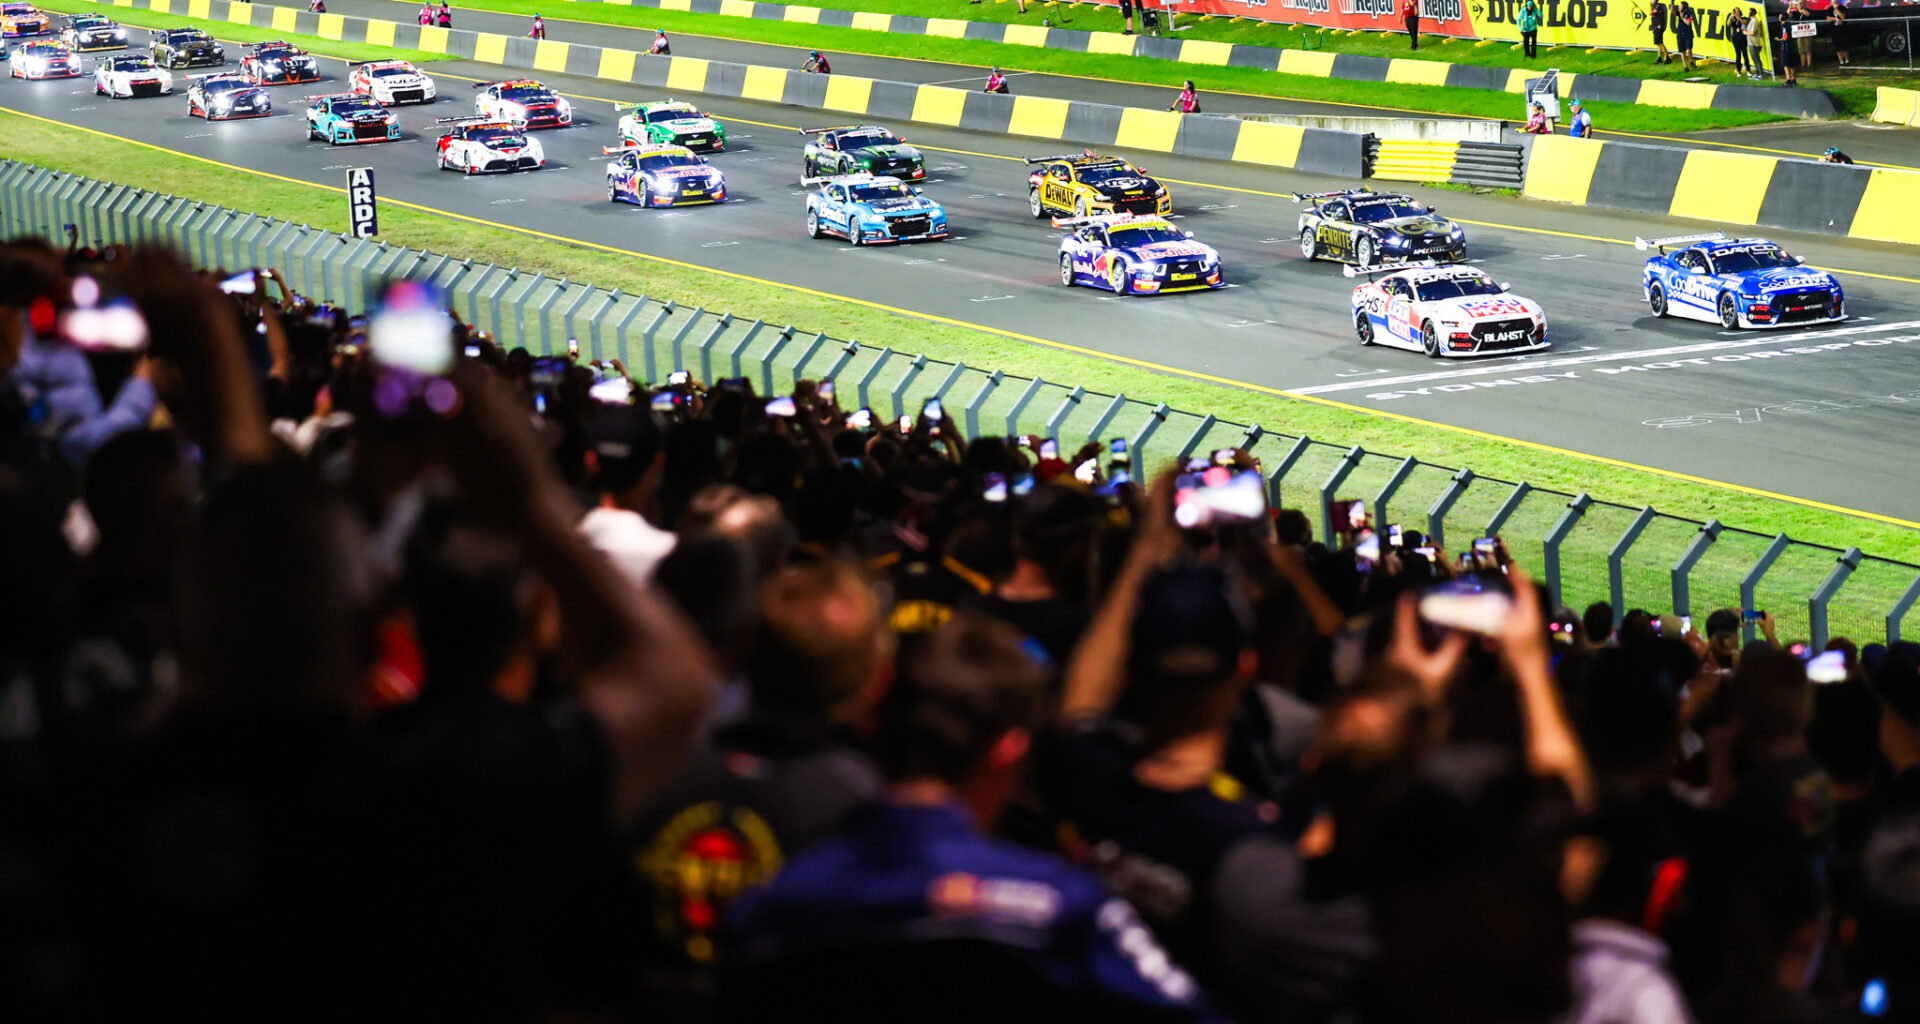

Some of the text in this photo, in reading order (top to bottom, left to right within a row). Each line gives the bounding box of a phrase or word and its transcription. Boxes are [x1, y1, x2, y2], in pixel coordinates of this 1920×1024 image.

[1423, 0, 1462, 22] Repco
[351, 169, 374, 237] ARDC
[1316, 225, 1352, 250] PENRITE
[1714, 245, 1778, 257] DAYCO
[1418, 271, 1481, 285] DAYCO
[1468, 304, 1527, 317] MOLY
[1484, 330, 1525, 342] BLAHST
[1366, 334, 1920, 400] SYDNEY MOTORSPOR
